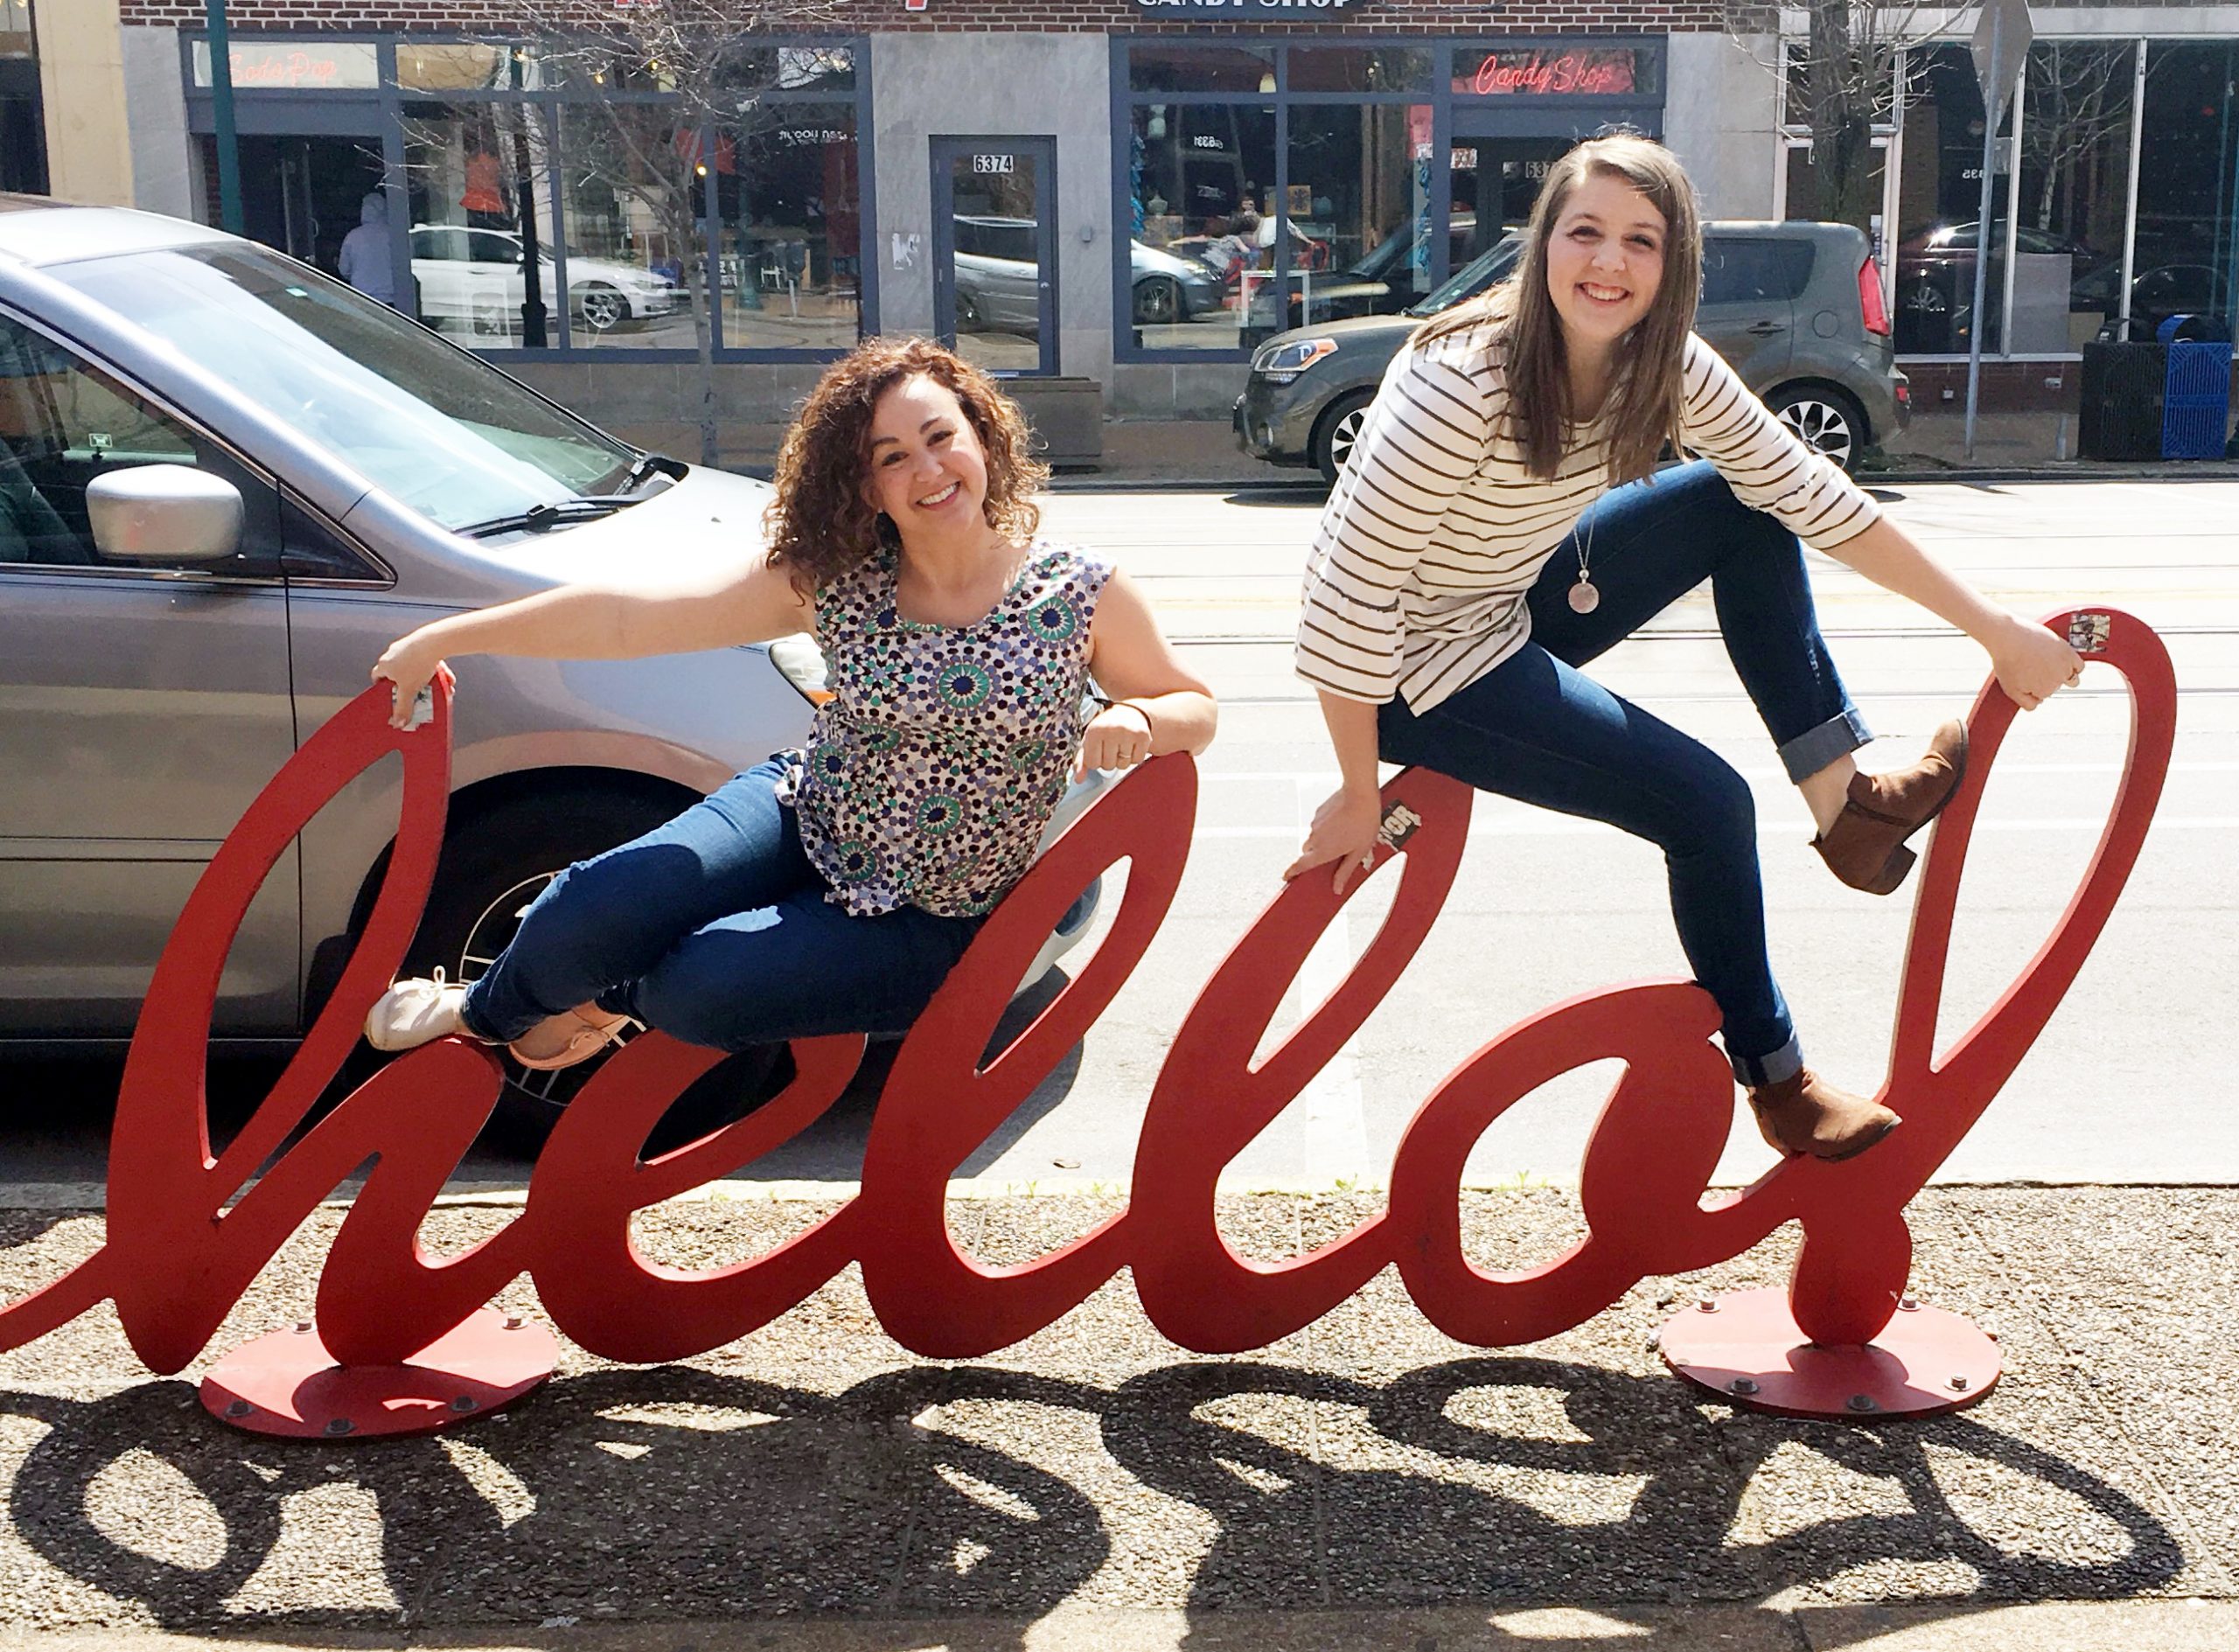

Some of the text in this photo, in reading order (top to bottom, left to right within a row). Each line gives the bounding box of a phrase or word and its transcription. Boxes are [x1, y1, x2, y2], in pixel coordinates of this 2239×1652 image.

[287, 51, 337, 86] Pop
[1476, 54, 1611, 94] Candy Shop
[974, 156, 1013, 172] 6374
